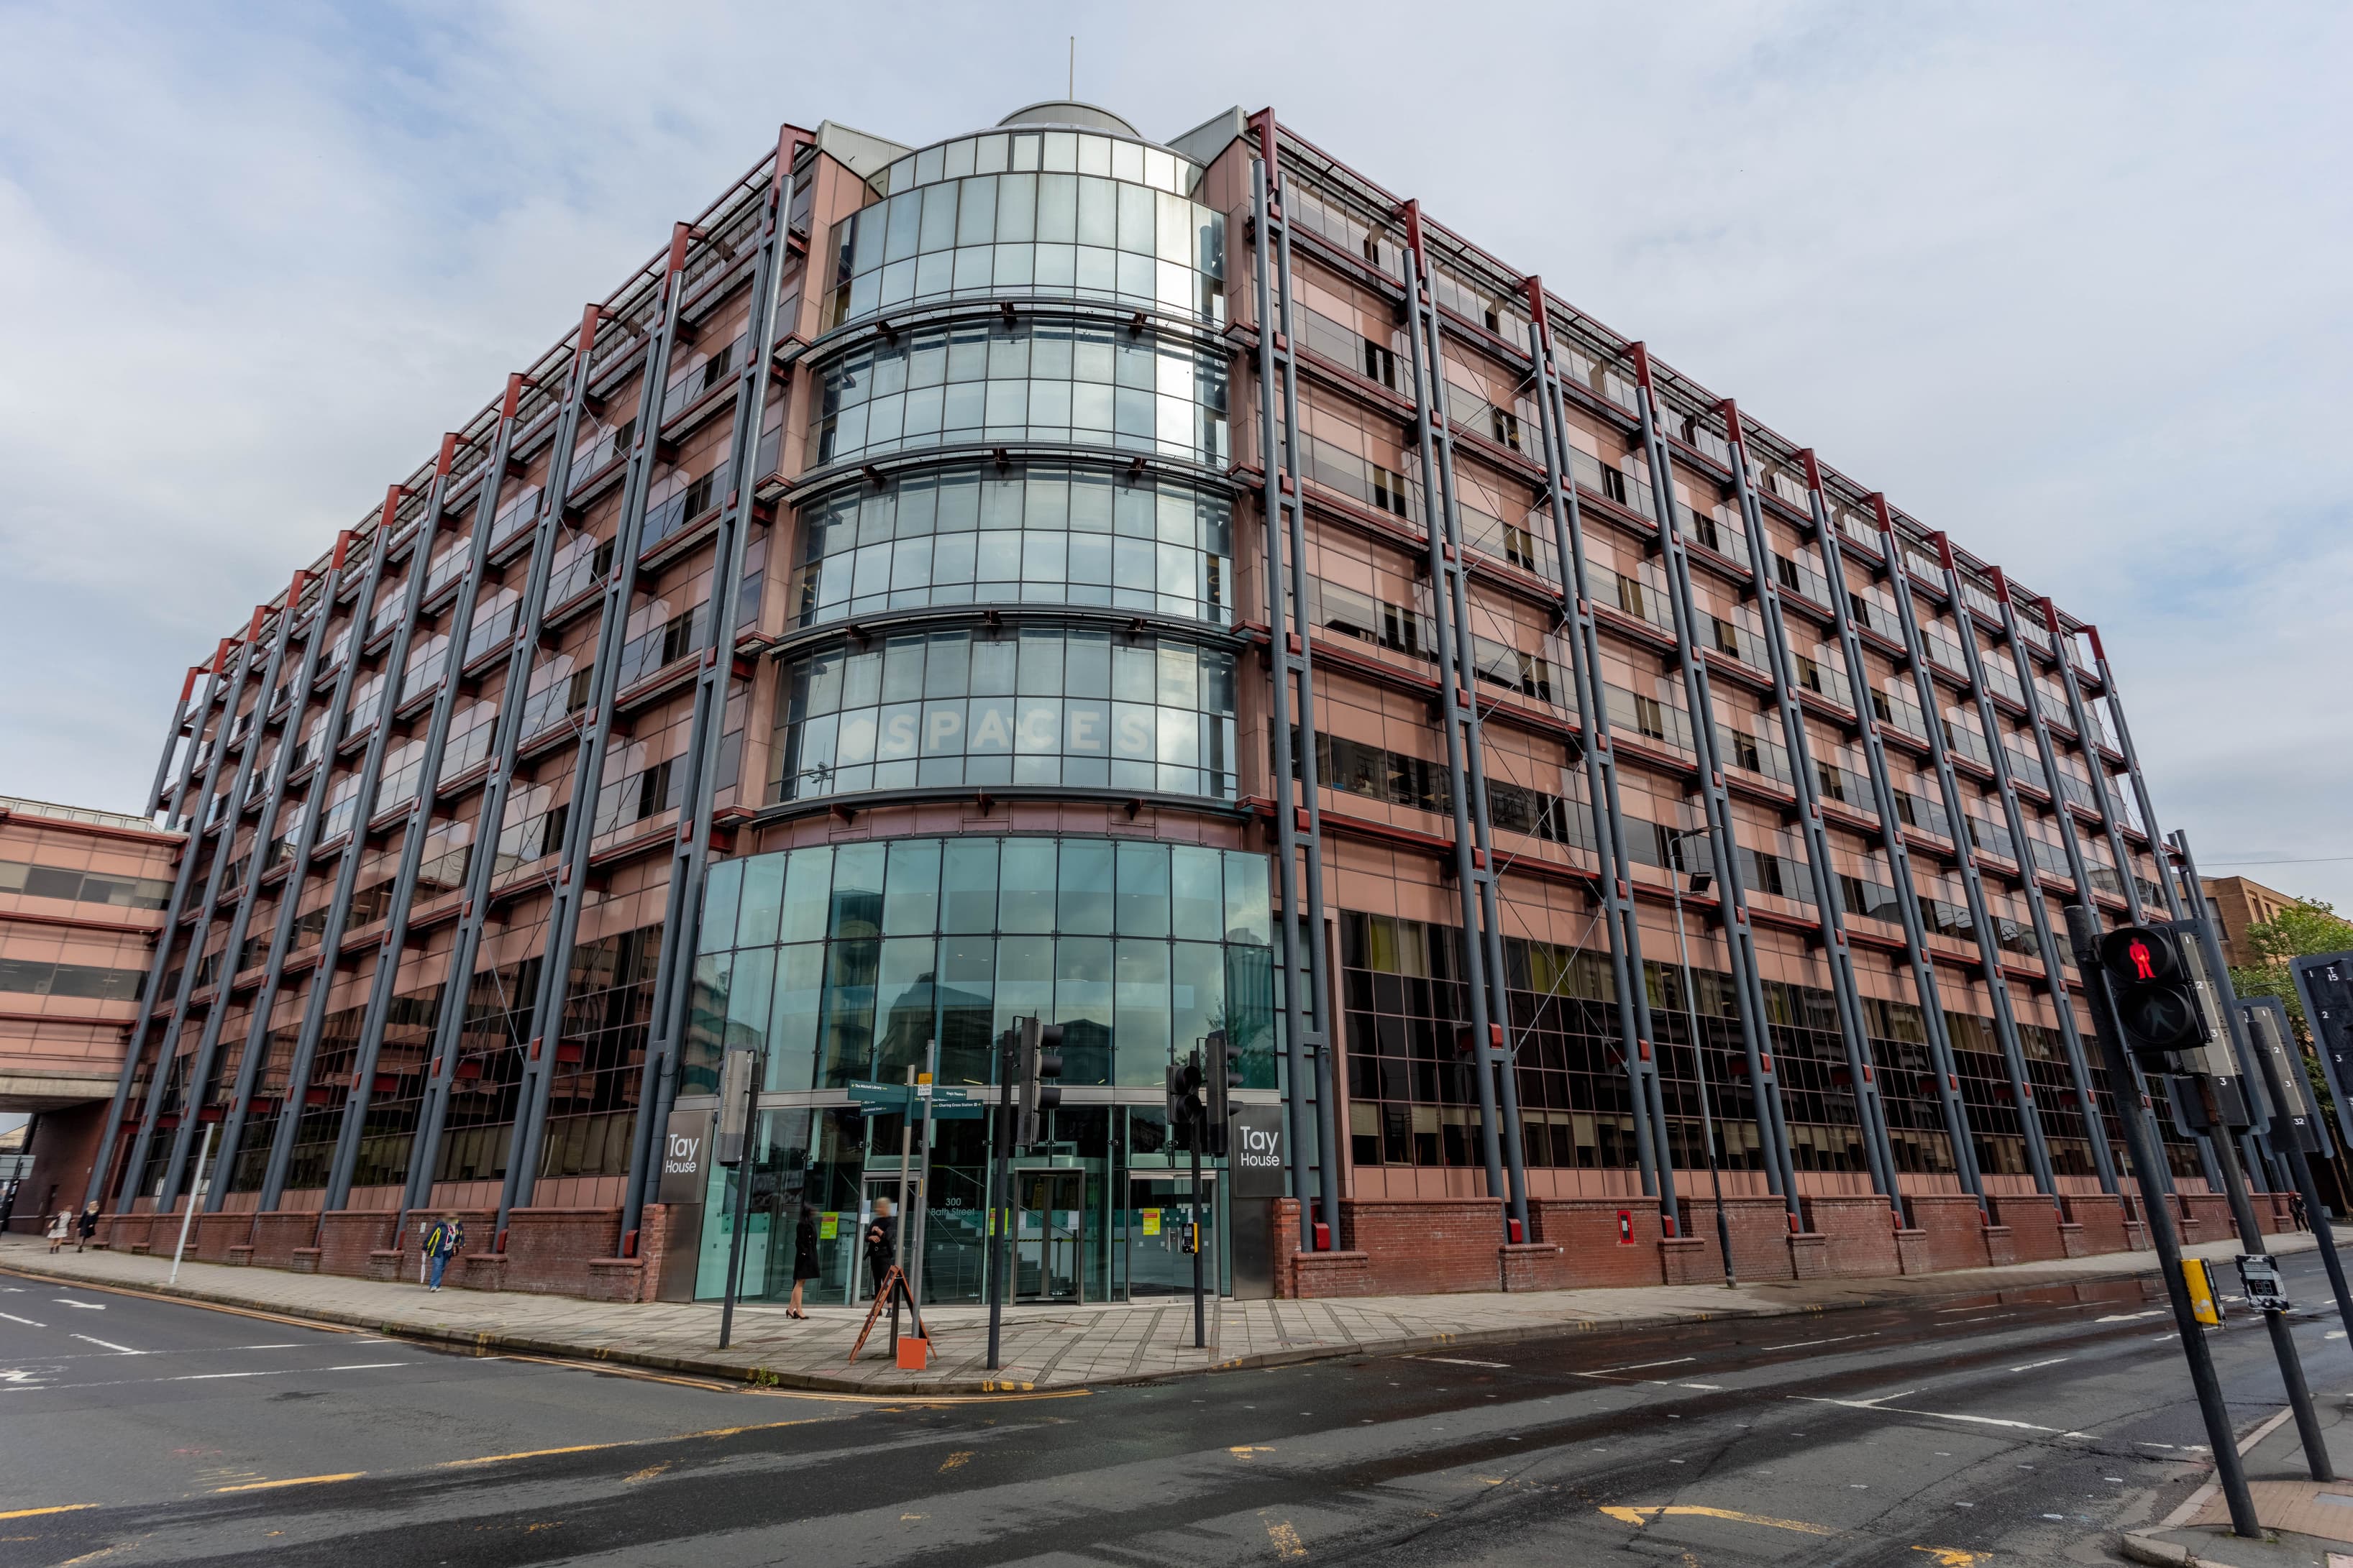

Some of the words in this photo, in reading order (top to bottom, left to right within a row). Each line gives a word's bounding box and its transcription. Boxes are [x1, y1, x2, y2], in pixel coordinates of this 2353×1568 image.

[884, 708, 1149, 753] SPACES
[2196, 981, 2204, 989] 2
[2211, 1029, 2219, 1037] 3
[2335, 1054, 2342, 1063] 3
[2220, 1077, 2227, 1086] 3
[1239, 1126, 1279, 1155] Tay
[669, 1133, 700, 1162] Tay
[1241, 1152, 1280, 1167] House
[664, 1160, 697, 1173] House
[945, 1197, 961, 1206] 300
[931, 1208, 949, 1216] Bath
[951, 1208, 975, 1216] Street
